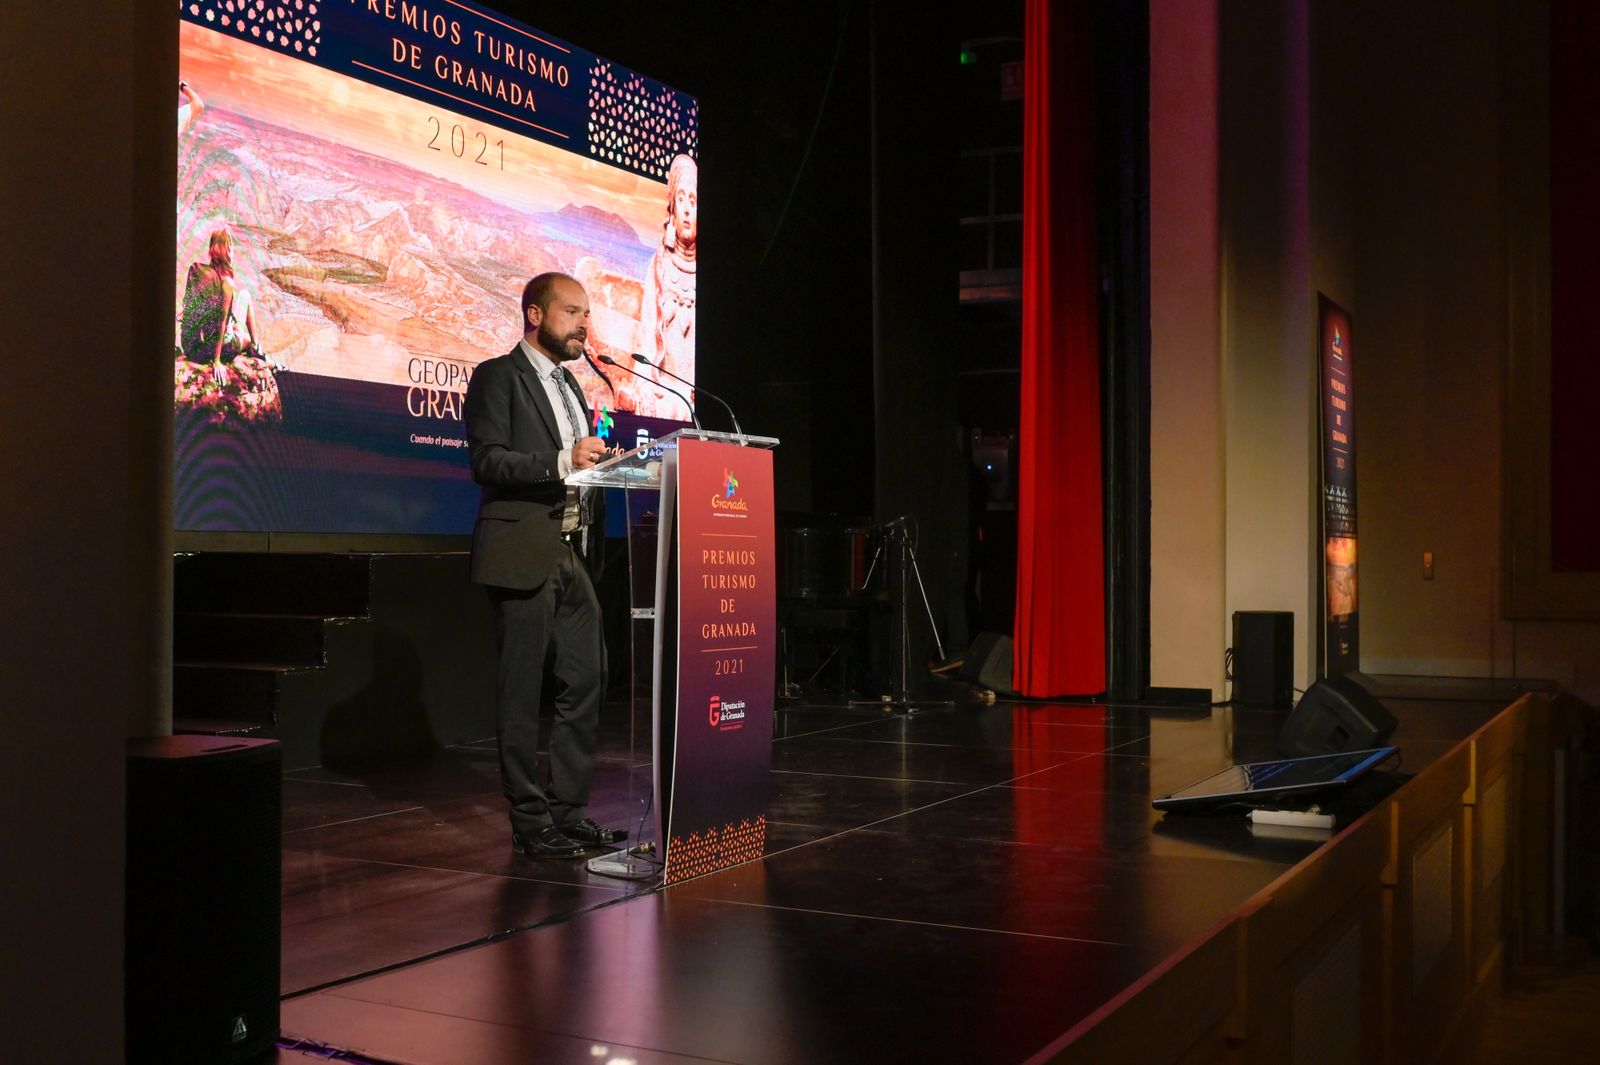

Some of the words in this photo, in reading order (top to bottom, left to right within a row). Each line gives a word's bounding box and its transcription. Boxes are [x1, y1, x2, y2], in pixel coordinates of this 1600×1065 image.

[351, 0, 461, 45] REMIOS
[474, 31, 569, 87] TURISMO
[392, 37, 422, 70] DE
[435, 55, 536, 112] GRANADA
[427, 116, 504, 171] 2021
[408, 357, 475, 388] GEOPA
[410, 433, 434, 445] Cuando
[442, 438, 463, 448] paisaje
[711, 493, 748, 511] Granada
[702, 550, 756, 565] PREMIOS
[702, 574, 756, 589] TURISMO
[720, 598, 735, 613] DE
[702, 622, 756, 639] GRANADA
[715, 658, 743, 675] 2021
[721, 701, 745, 711] Diputación
[726, 710, 745, 720] Granada
